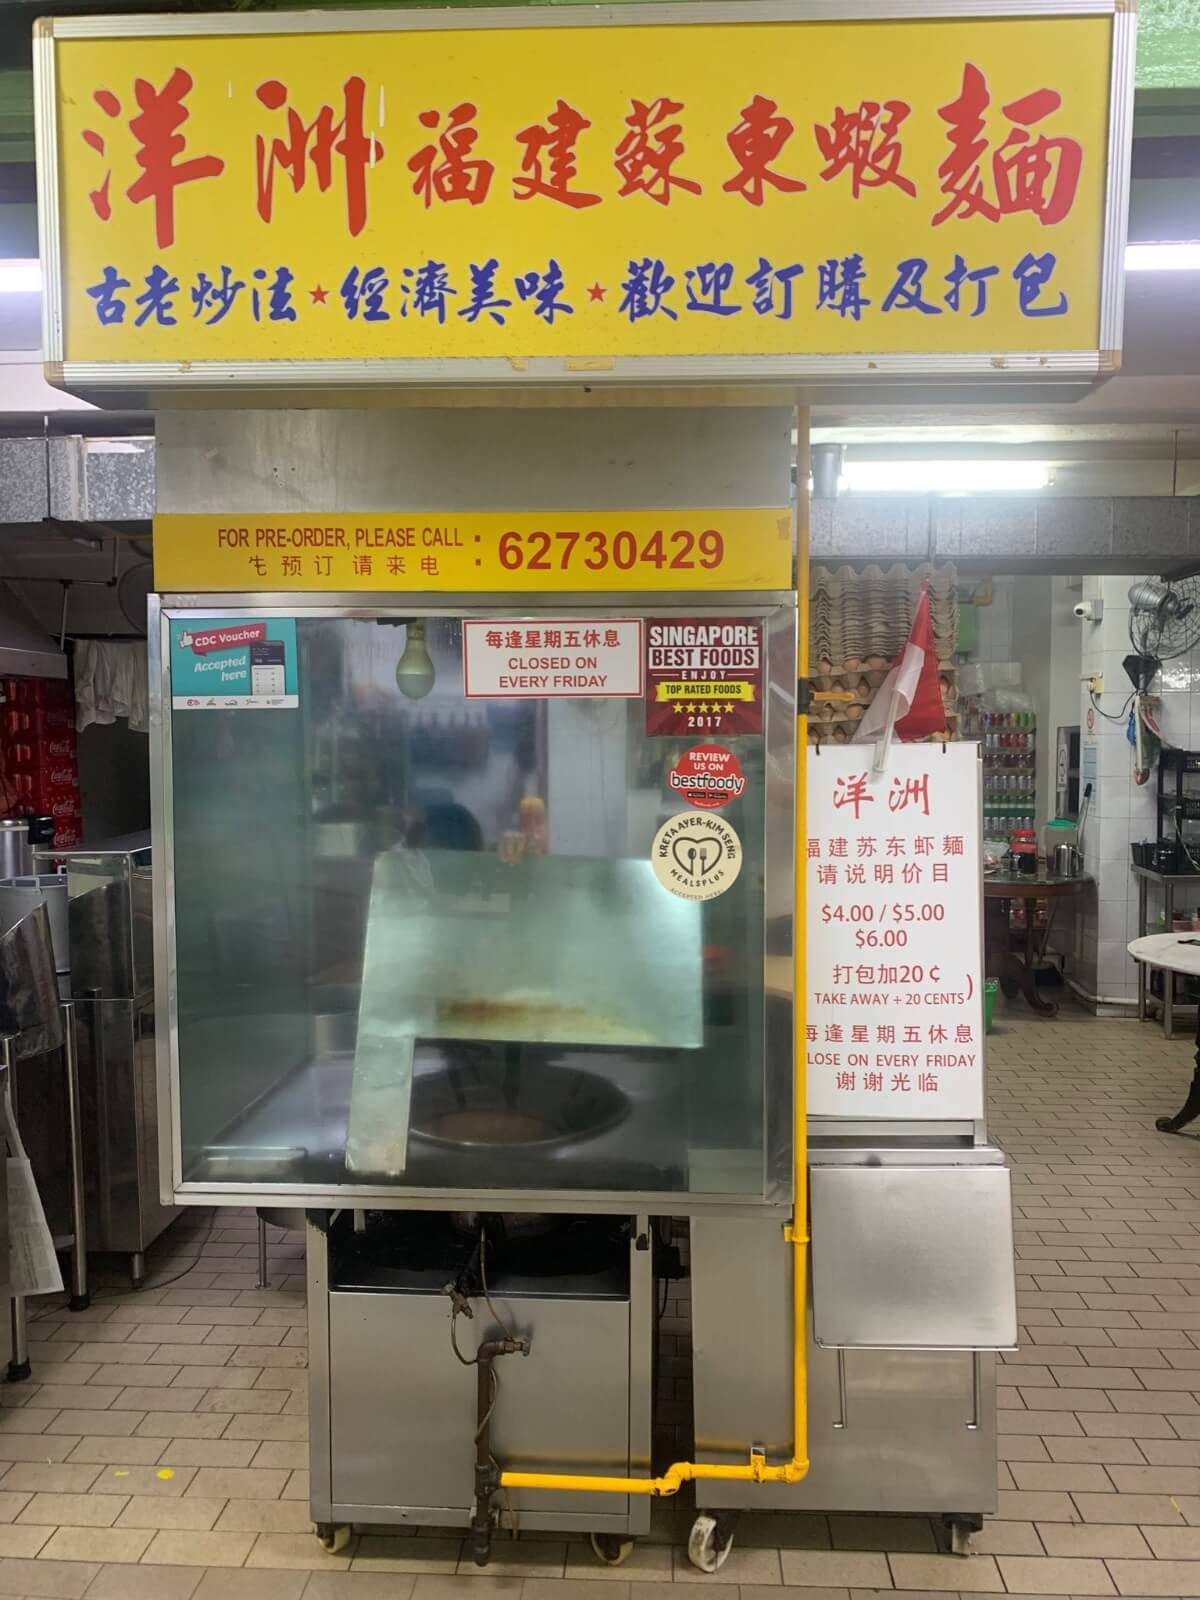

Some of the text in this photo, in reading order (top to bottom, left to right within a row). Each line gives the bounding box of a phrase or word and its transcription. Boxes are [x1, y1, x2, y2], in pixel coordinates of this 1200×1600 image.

[86, 252, 1069, 326] 古老炒法 經濟美味 歡迎訂購及打包
[218, 528, 249, 548] FOR
[256, 528, 350, 550] PRE-ORDER,
[355, 527, 415, 547] PLEASE
[422, 528, 463, 546] CALL
[498, 529, 724, 570] 62730429
[194, 628, 261, 648] CDC Voucher
[485, 629, 621, 649] 每逢星期五休息
[649, 625, 759, 646] SINGAPORE
[194, 656, 247, 674] Accepted
[508, 657, 597, 670] CLOSED ON
[652, 648, 755, 667] BEST FOODS
[221, 669, 247, 682] here
[499, 675, 608, 688] EVERY FRIDAY
[681, 670, 727, 680] ENJOY
[666, 684, 742, 695] TOP RATED FOODS
[688, 716, 722, 728] 2017
[689, 752, 730, 762] REVIEW
[708, 763, 724, 771] ON
[670, 771, 745, 794] bestfoody
[832, 771, 930, 819] 洋洲
[659, 828, 679, 858] KRETA
[722, 833, 736, 860] SENG
[817, 863, 949, 885] 请说明价目
[821, 904, 874, 923] $4.00
[893, 903, 945, 923] $5.00
[855, 929, 909, 948] $6.00
[815, 993, 847, 1005] TAKE
[851, 993, 889, 1005] AWAY
[905, 993, 921, 1005] 20
[924, 992, 965, 1005] CENTS
[807, 1053, 976, 1067] LOSE ON EVERY FRIDAY
[836, 1071, 939, 1092] 谢谢光临
